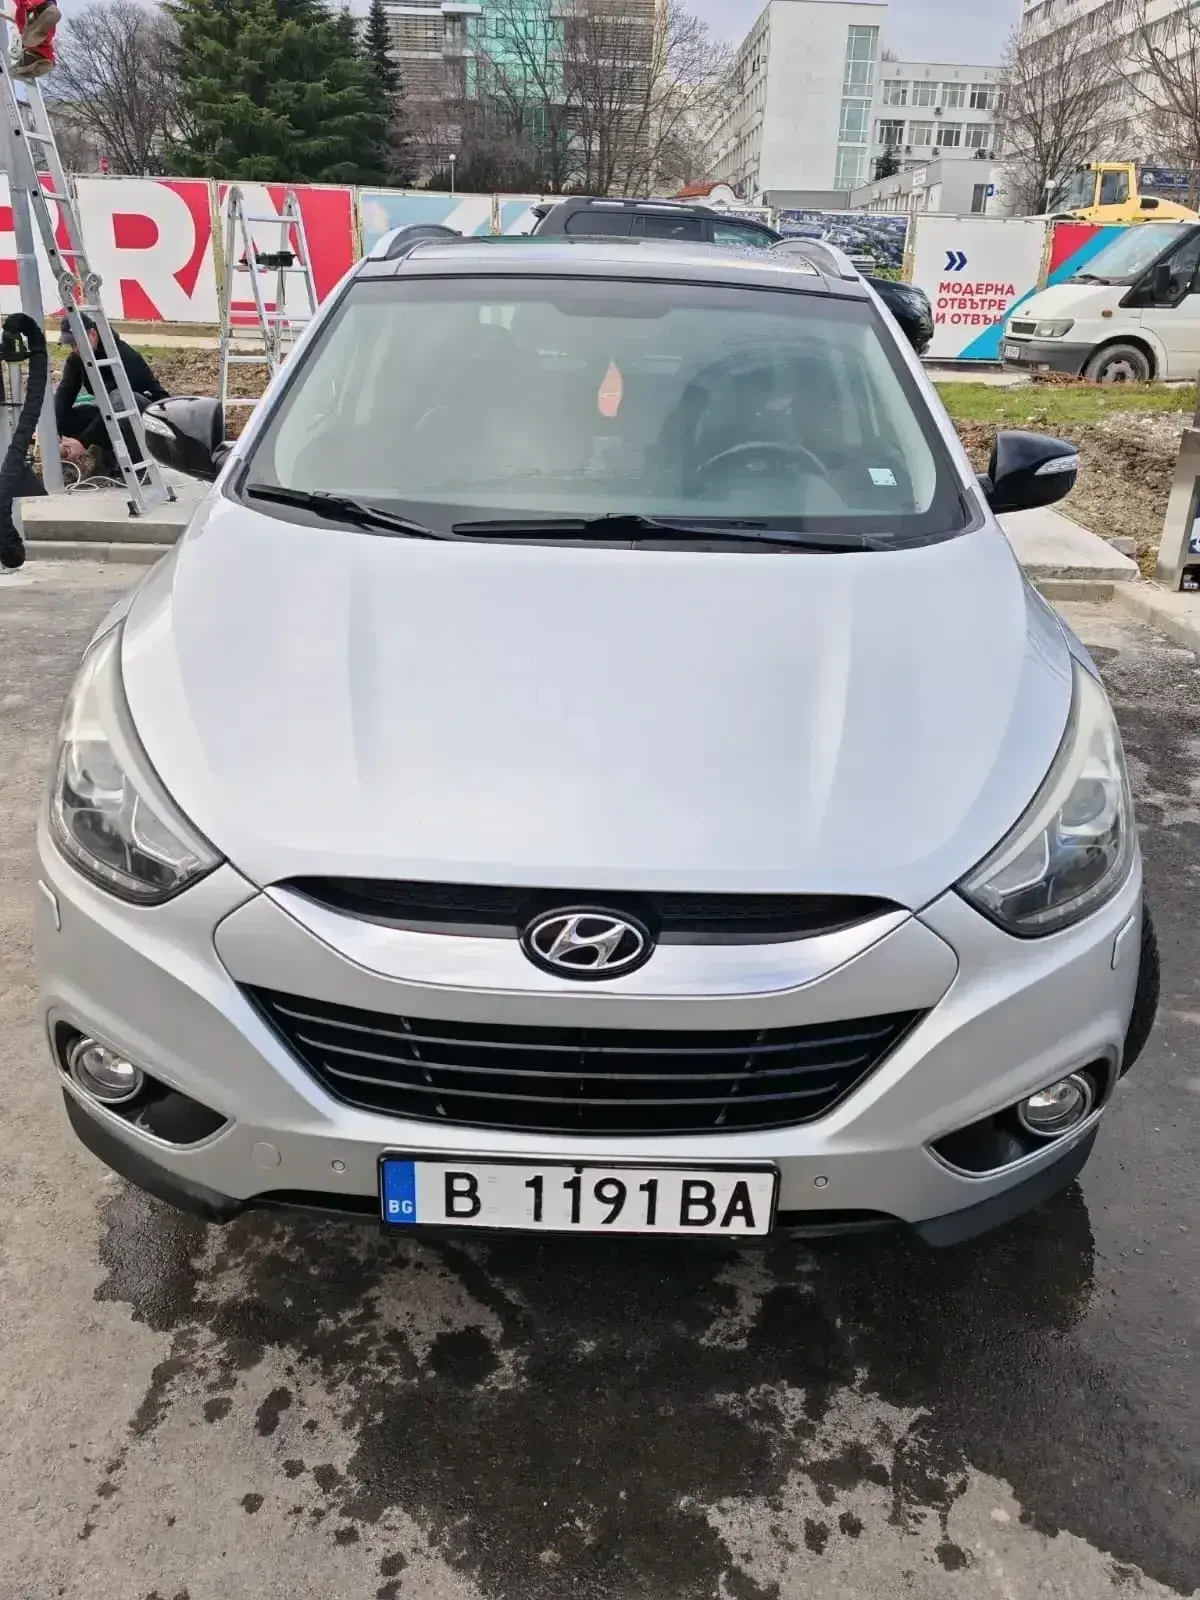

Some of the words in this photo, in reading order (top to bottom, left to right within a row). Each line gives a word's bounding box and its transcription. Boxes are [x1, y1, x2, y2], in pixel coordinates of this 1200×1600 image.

[938, 282, 1015, 296] МОДЕРНА
[937, 297, 1006, 310] ОТВЪТРЕ
[935, 312, 946, 324] И
[444, 1171, 482, 1218] B
[388, 1199, 413, 1215] BG
